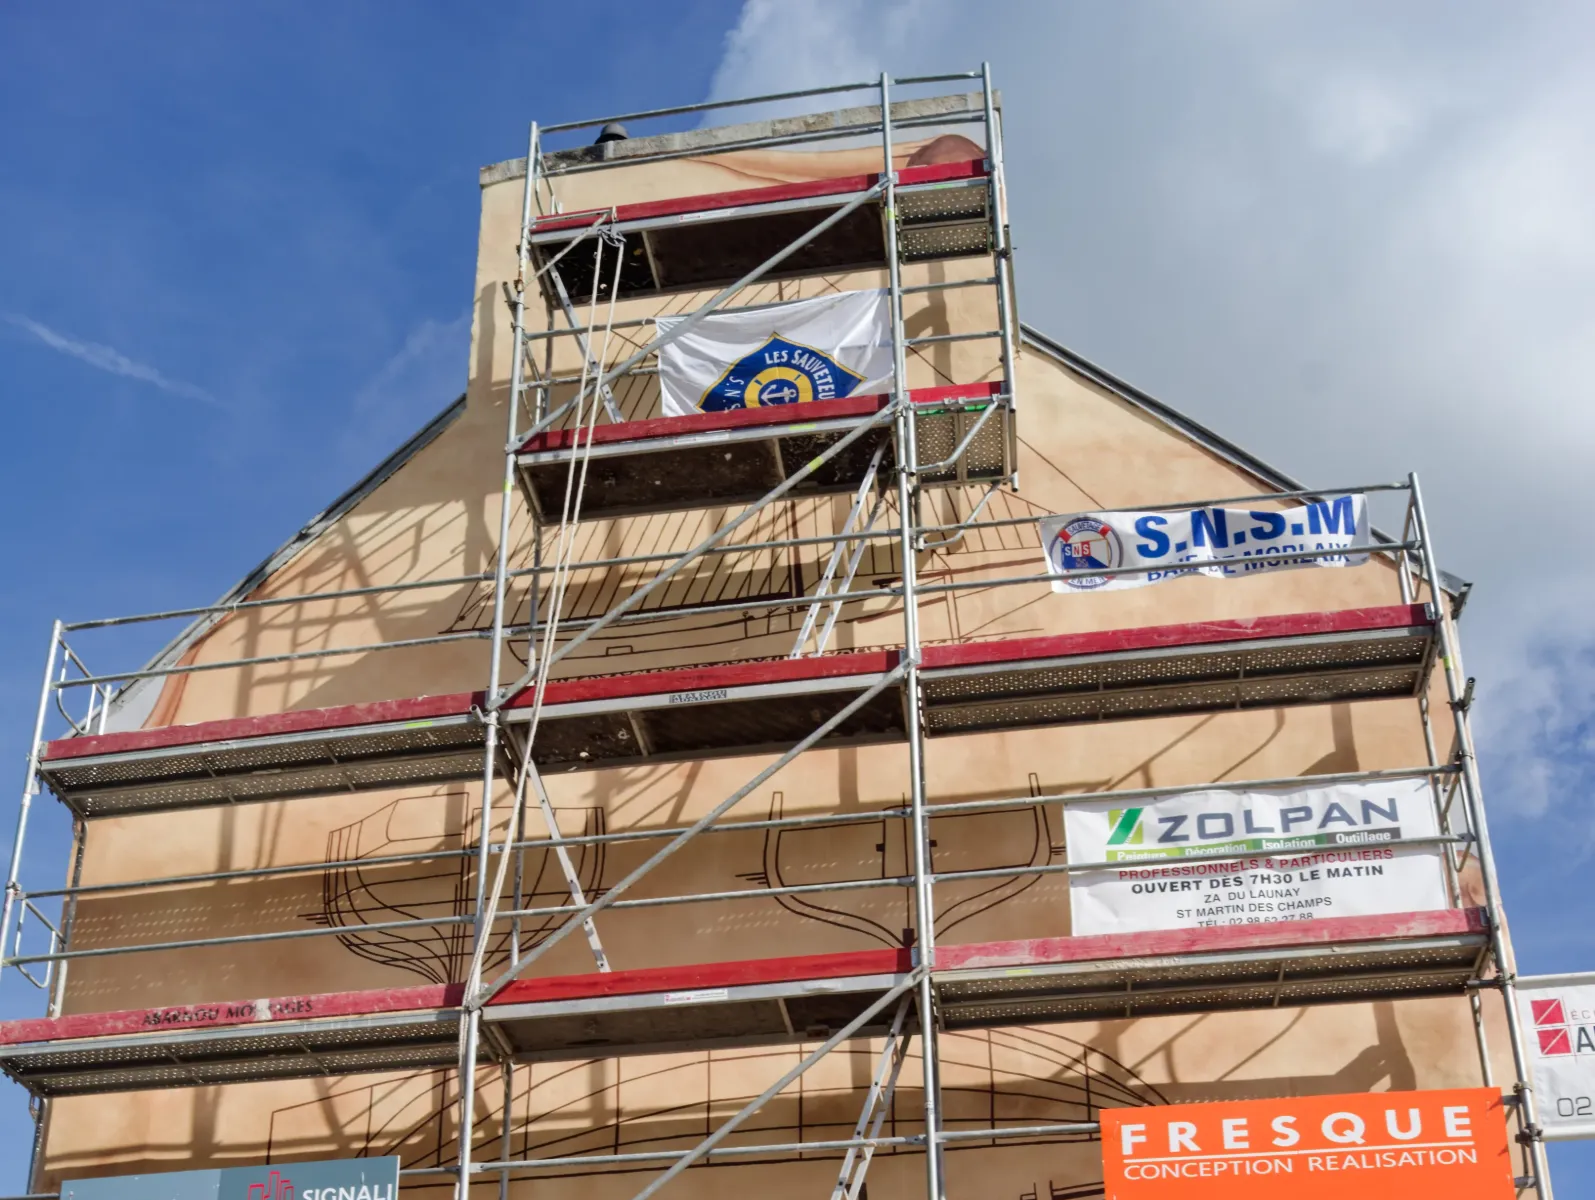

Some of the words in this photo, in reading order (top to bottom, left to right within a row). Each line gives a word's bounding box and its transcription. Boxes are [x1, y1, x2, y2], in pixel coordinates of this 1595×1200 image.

[765, 350, 789, 365] LES
[1135, 496, 1356, 558] S.N.S.M
[1157, 798, 1399, 844] ZOLPAN
[1262, 838, 1316, 850] Isolation
[1336, 831, 1391, 844] Outillage
[1119, 859, 1259, 880] PROFESSIONNELS
[1265, 859, 1274, 869] &
[1280, 849, 1394, 868] PARTICULIERS
[1132, 880, 1202, 894] OUVERT
[1210, 875, 1243, 889] DÈS
[1250, 873, 1293, 885] 7H30
[1300, 870, 1320, 882] LE
[1327, 865, 1383, 878] MATIN
[1176, 909, 1192, 919] ST
[1196, 904, 1245, 918] MARTIN
[1249, 903, 1274, 912] DES
[1278, 897, 1332, 912] CHAMPS
[1204, 894, 1221, 903] ZA
[1228, 891, 1246, 900] DU
[1250, 888, 1301, 899] LAUNAY
[1571, 1008, 1595, 1020] ÉC
[1576, 1025, 1595, 1053] A
[1557, 1096, 1593, 1117] 02
[1121, 1106, 1472, 1155] FRESQUE
[1124, 1158, 1293, 1180] CONCEPTION
[1308, 1149, 1478, 1172] REALISATION
